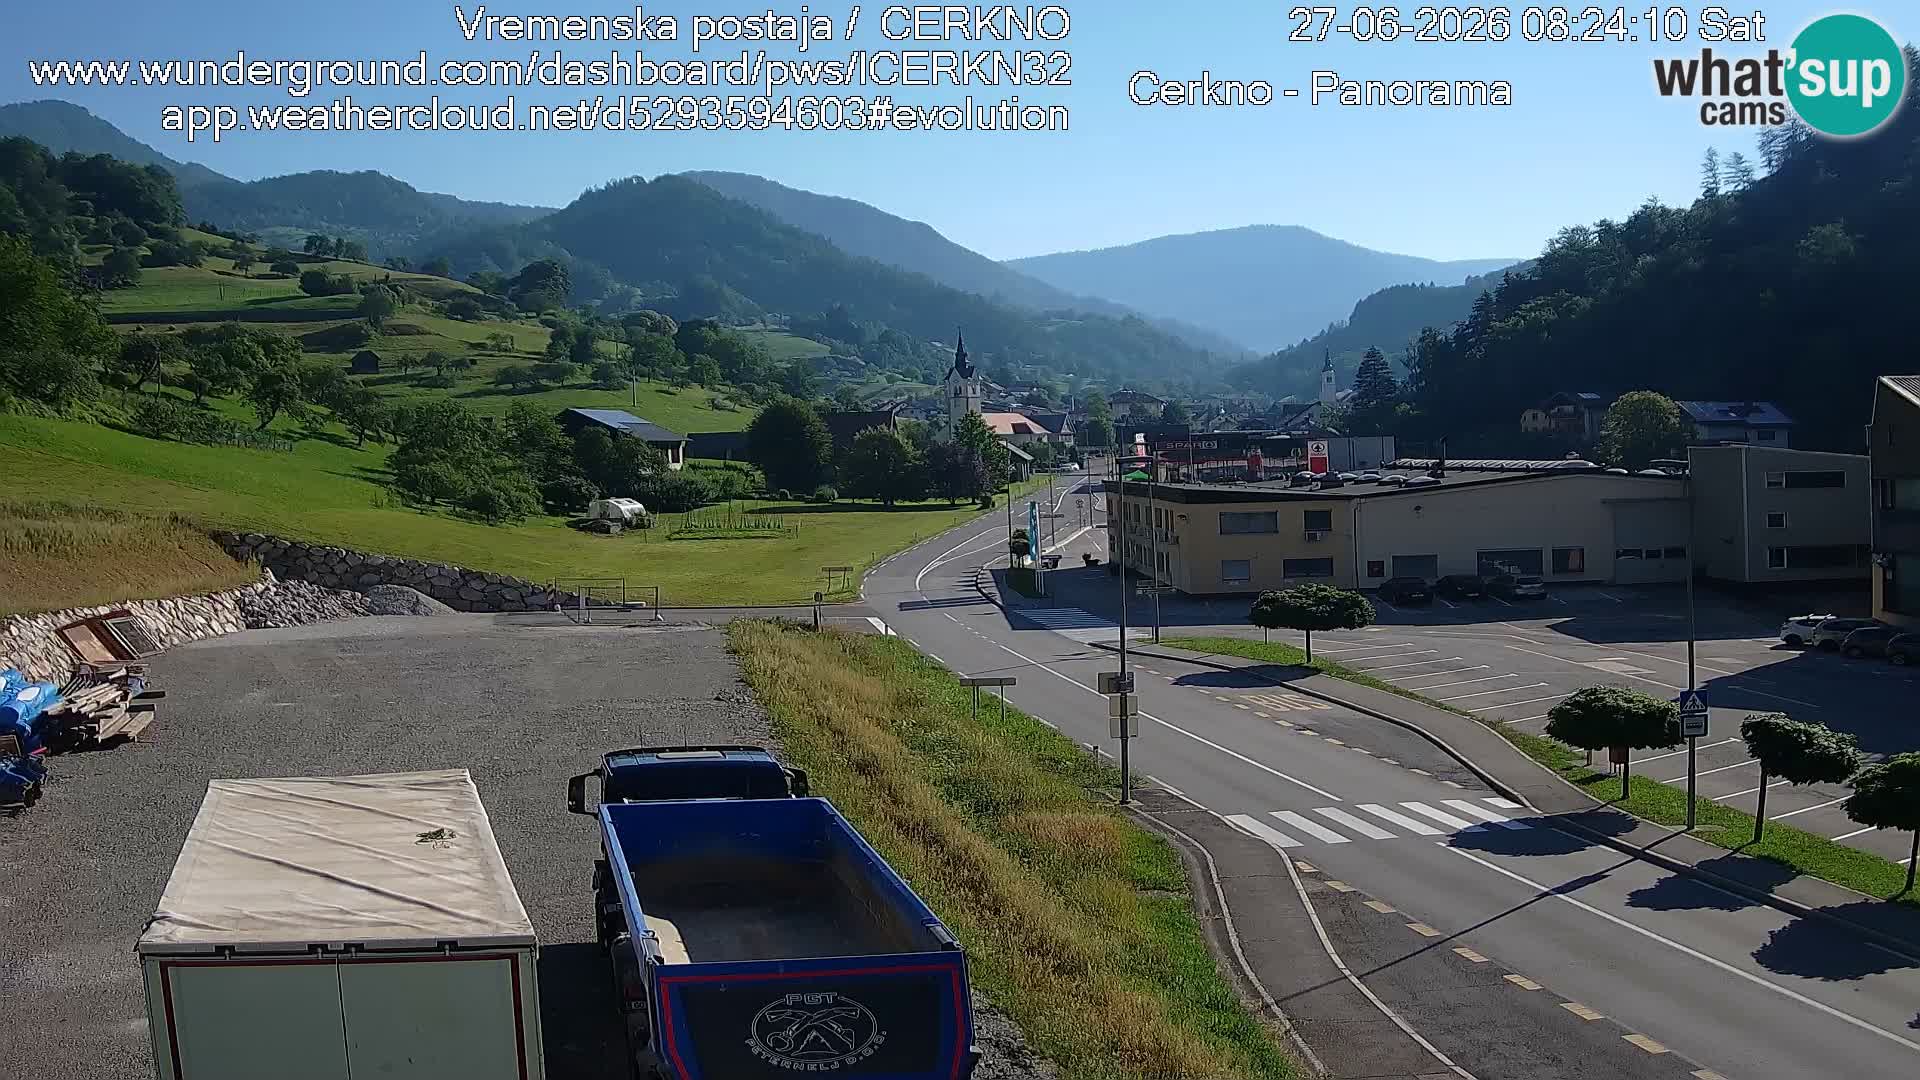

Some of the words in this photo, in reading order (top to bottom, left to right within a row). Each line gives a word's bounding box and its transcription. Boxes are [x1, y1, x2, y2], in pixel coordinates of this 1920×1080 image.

[1239, 694, 1333, 712] BUS
[785, 992, 838, 1006] PGT
[744, 1037, 840, 1072] PETERNELJ
